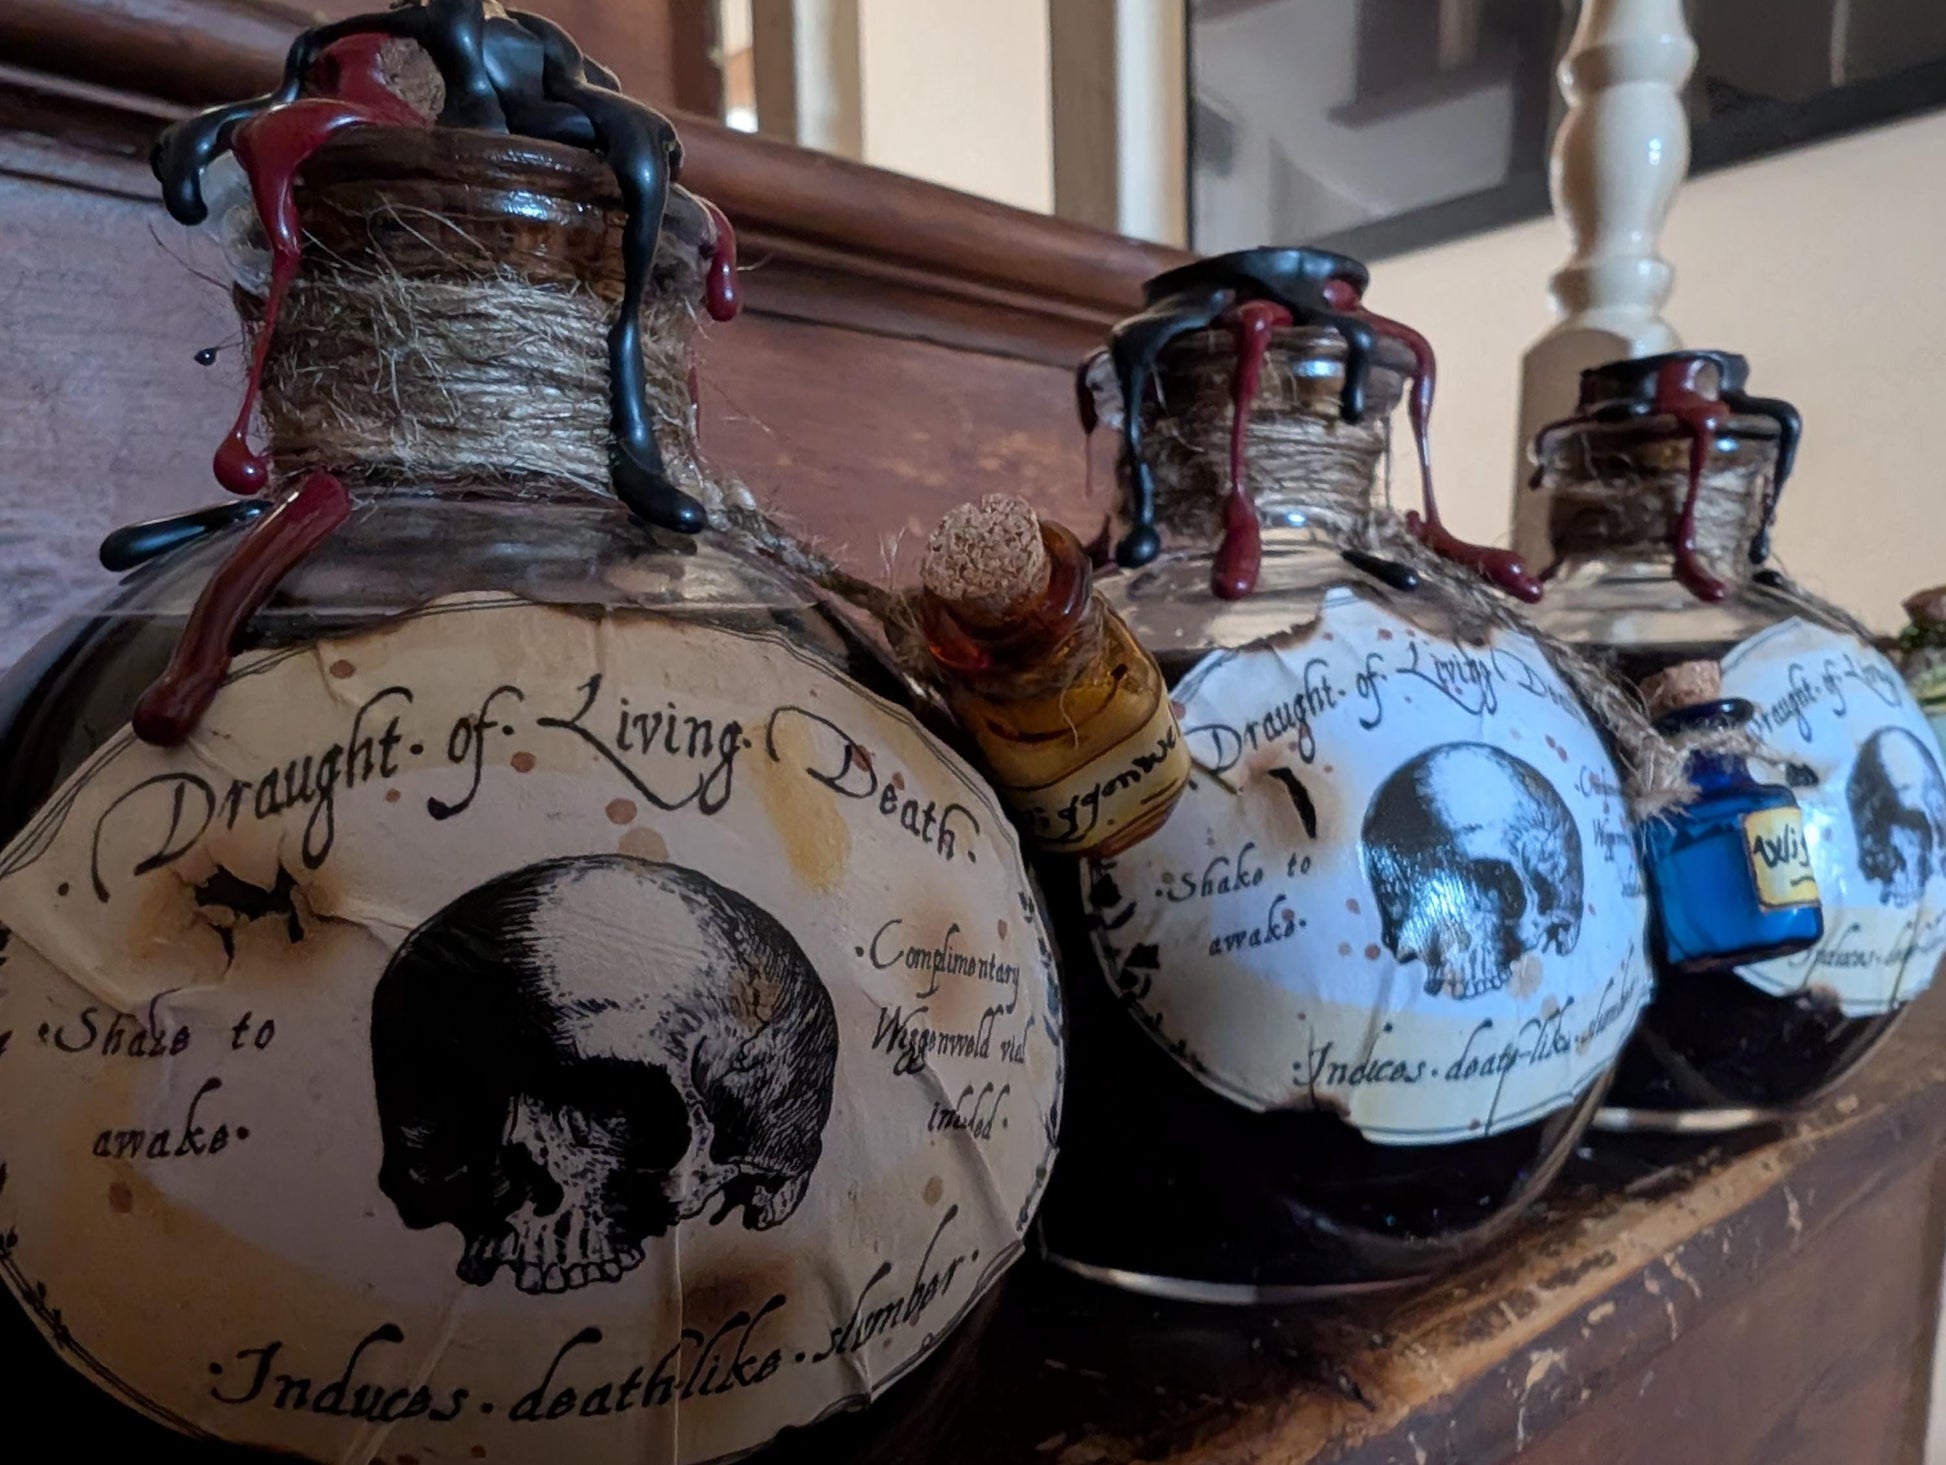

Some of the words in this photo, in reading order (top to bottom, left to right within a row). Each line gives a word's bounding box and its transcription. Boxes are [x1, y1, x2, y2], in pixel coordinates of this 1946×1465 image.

[1184, 658, 1337, 774] Draught
[1355, 652, 1384, 731] of
[91, 685, 414, 903] Draught
[427, 685, 524, 821] of
[537, 673, 744, 816] Living
[767, 705, 981, 862] Death
[1166, 841, 1264, 902] Shake
[1287, 852, 1311, 878] to
[869, 918, 1020, 1015] Complimentary
[1208, 893, 1296, 957] awake
[54, 986, 192, 1058] Shake
[231, 1010, 276, 1050] to
[871, 1002, 1005, 1077] Wiggenweld
[1001, 1014, 1035, 1064] vial
[91, 1076, 230, 1160] awake
[210, 1322, 470, 1423] Induces
[811, 1203, 966, 1364] slumber
